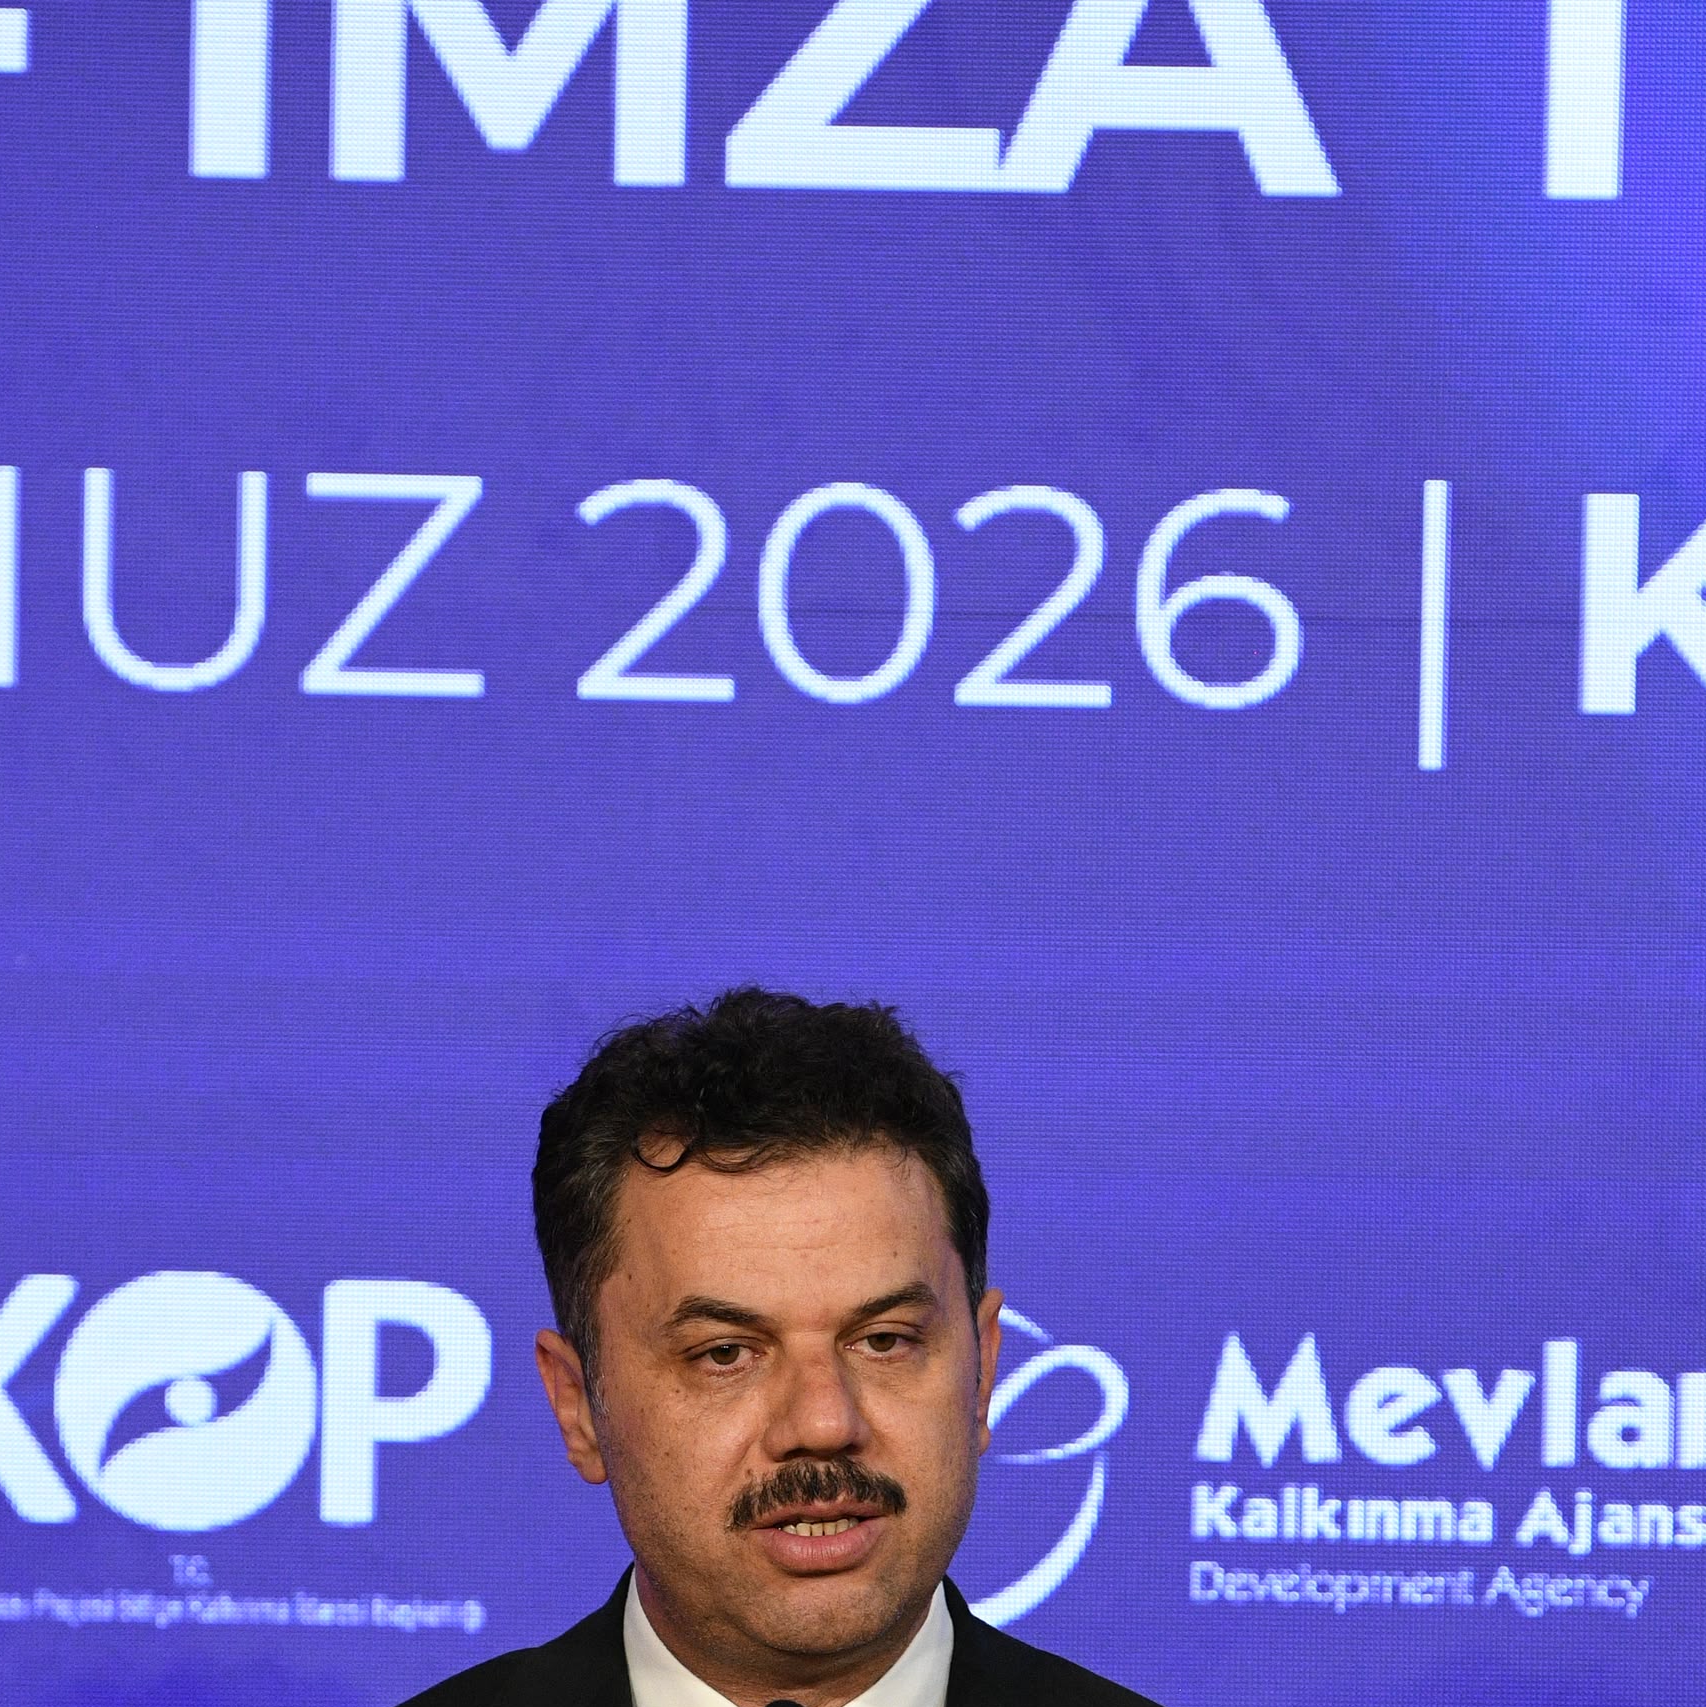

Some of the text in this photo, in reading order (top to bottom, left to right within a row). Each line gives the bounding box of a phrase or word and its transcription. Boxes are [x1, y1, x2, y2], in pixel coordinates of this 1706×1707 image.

[578, 479, 1301, 708] 2026
[1193, 1484, 1493, 1542] Kalkınma
[1191, 1561, 1649, 1616] Development Agency
